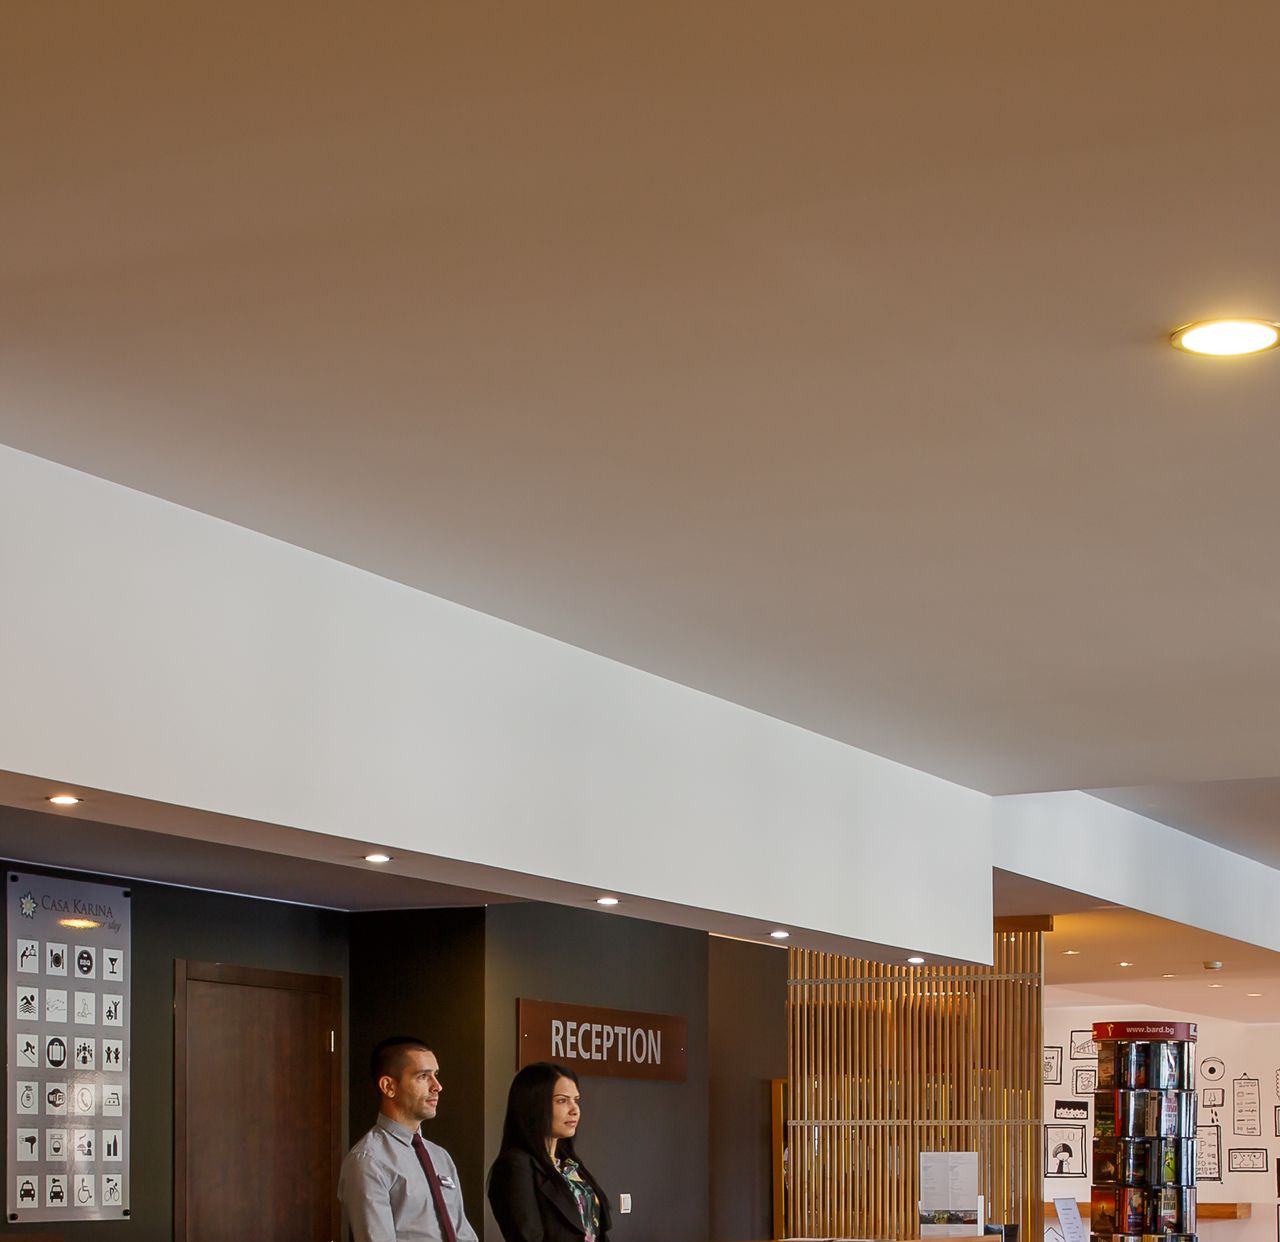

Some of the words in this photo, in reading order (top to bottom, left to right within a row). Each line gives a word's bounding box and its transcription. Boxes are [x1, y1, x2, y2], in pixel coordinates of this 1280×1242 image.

[73, 899, 113, 918] KARINA
[1125, 1026, 1176, 1035] www.bard.bg
[551, 1019, 662, 1065] RECEPTION
